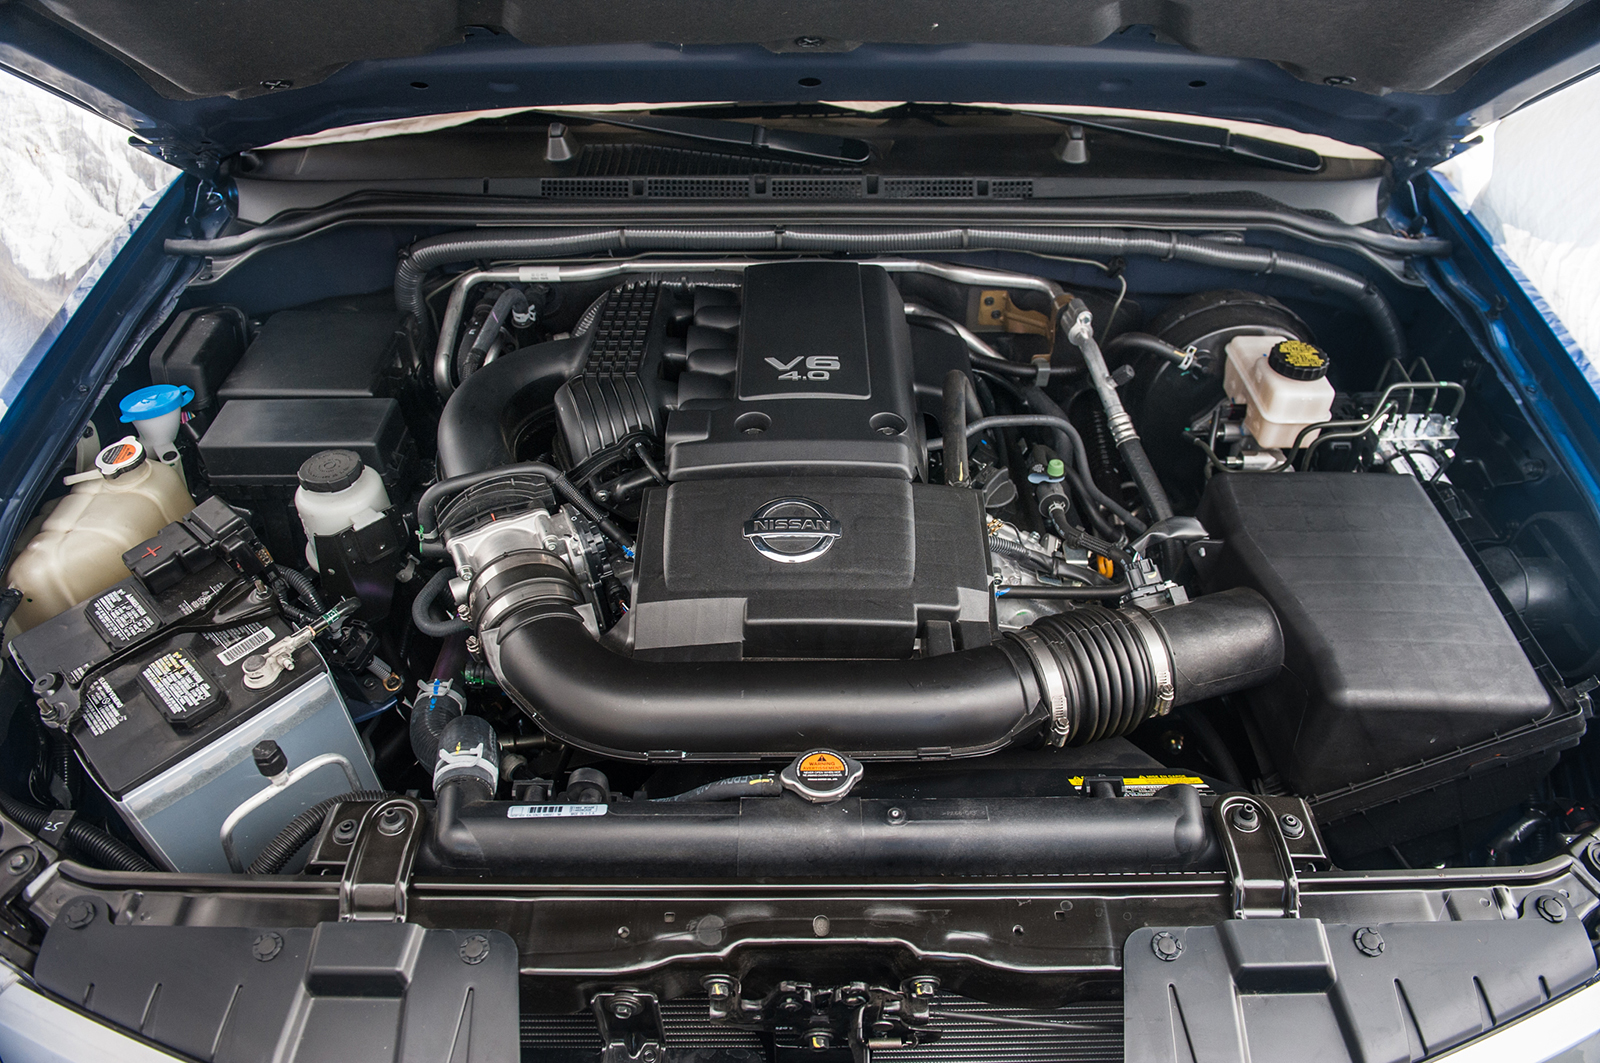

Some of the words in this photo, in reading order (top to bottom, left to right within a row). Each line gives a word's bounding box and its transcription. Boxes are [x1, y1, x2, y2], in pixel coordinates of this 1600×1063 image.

[764, 355, 841, 371] V6
[778, 370, 830, 381] 4.0
[753, 519, 831, 531] NISSAN
[44, 821, 64, 832] 25
